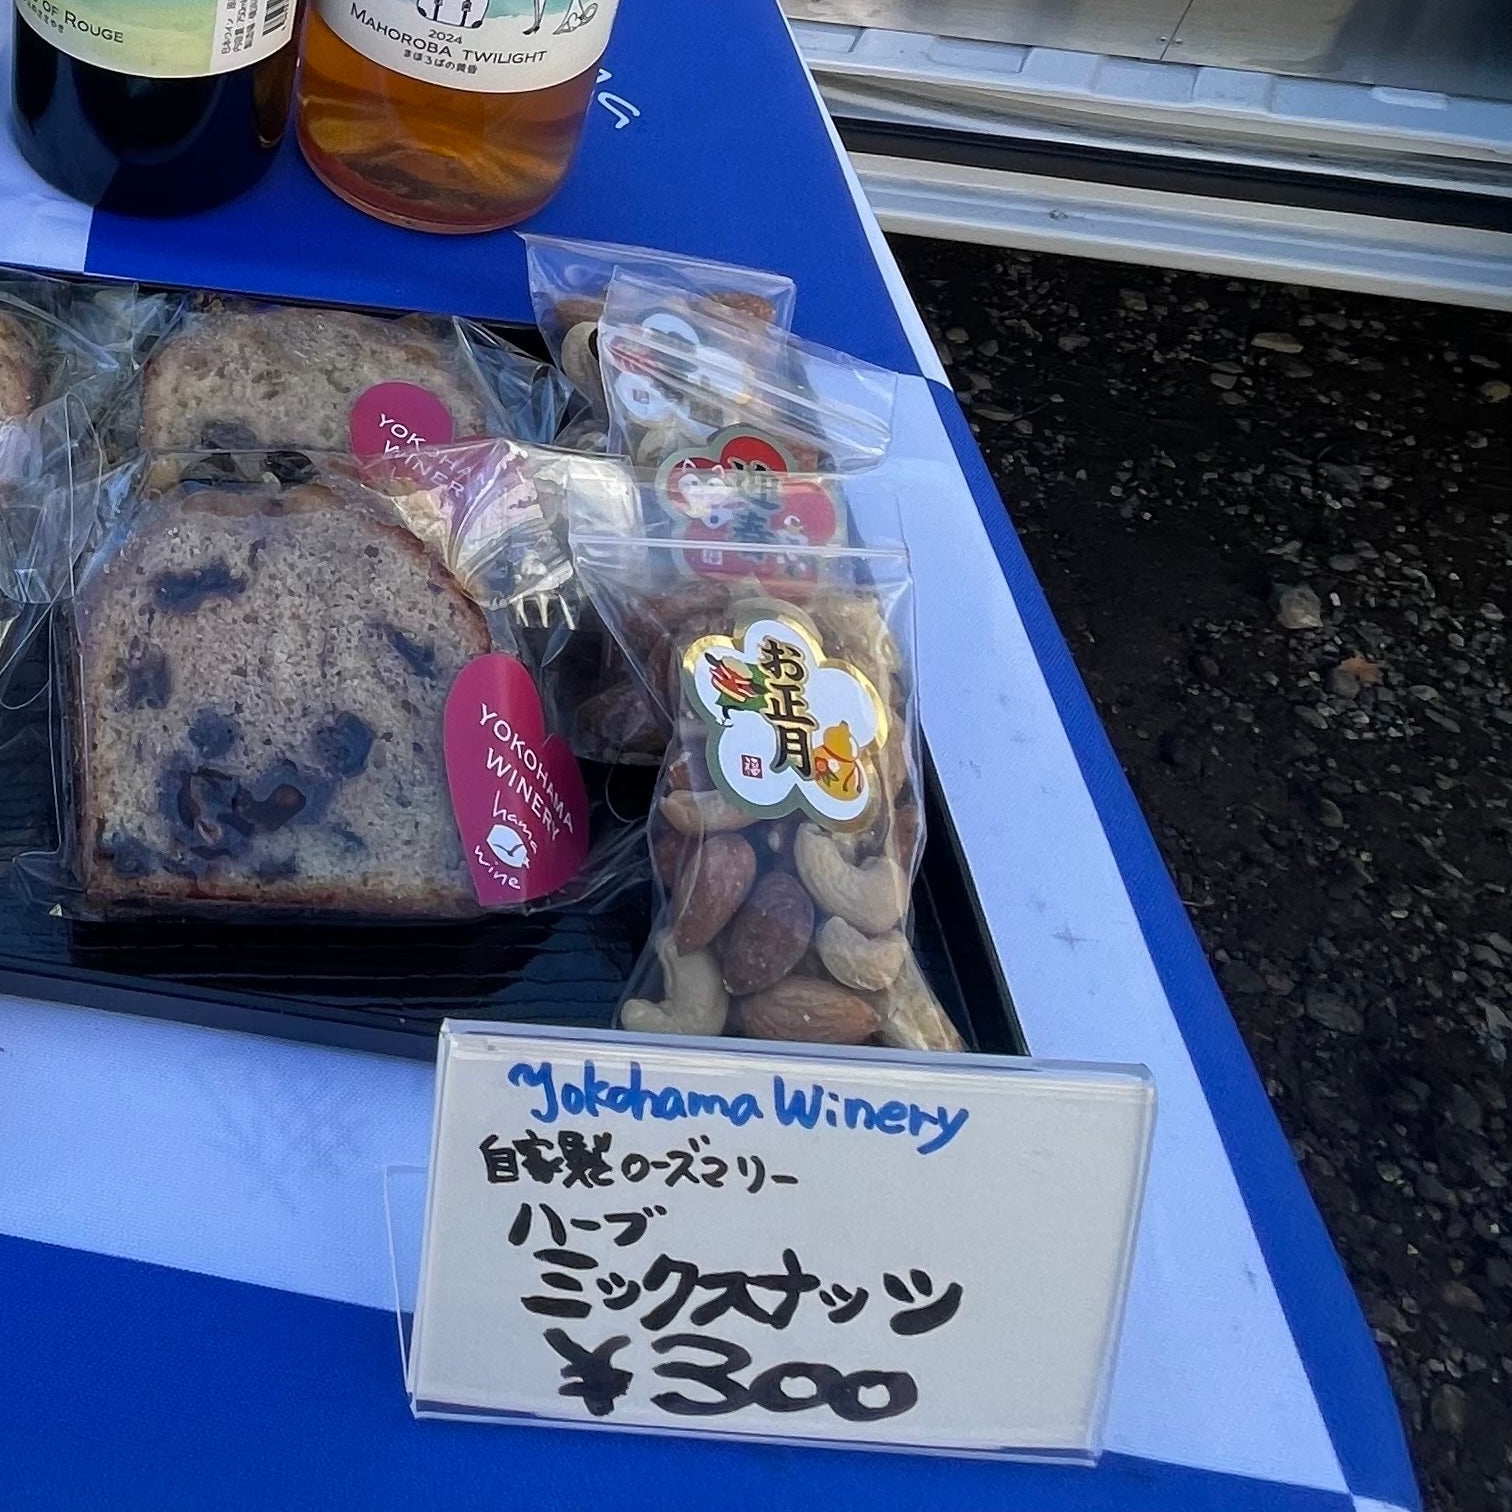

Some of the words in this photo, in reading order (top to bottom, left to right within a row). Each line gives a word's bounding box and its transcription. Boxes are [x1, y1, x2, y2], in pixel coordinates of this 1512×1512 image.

[64, 9, 124, 44] ROUGE
[350, 2, 453, 58] MAHOROBA
[462, 49, 548, 65] TWILIGHT
[427, 29, 463, 45] 2024
[760, 637, 813, 781] お正月
[479, 703, 574, 834] YOKOHAMA
[486, 747, 560, 841] WINERY
[492, 790, 538, 855] hama
[475, 845, 521, 889] wine
[508, 1060, 763, 1126] Yokohama
[772, 1075, 970, 1155] Winery
[508, 1202, 666, 1248] ハーブ
[520, 1248, 963, 1337] ミックスナッツ
[543, 1327, 919, 1422] ¥300
